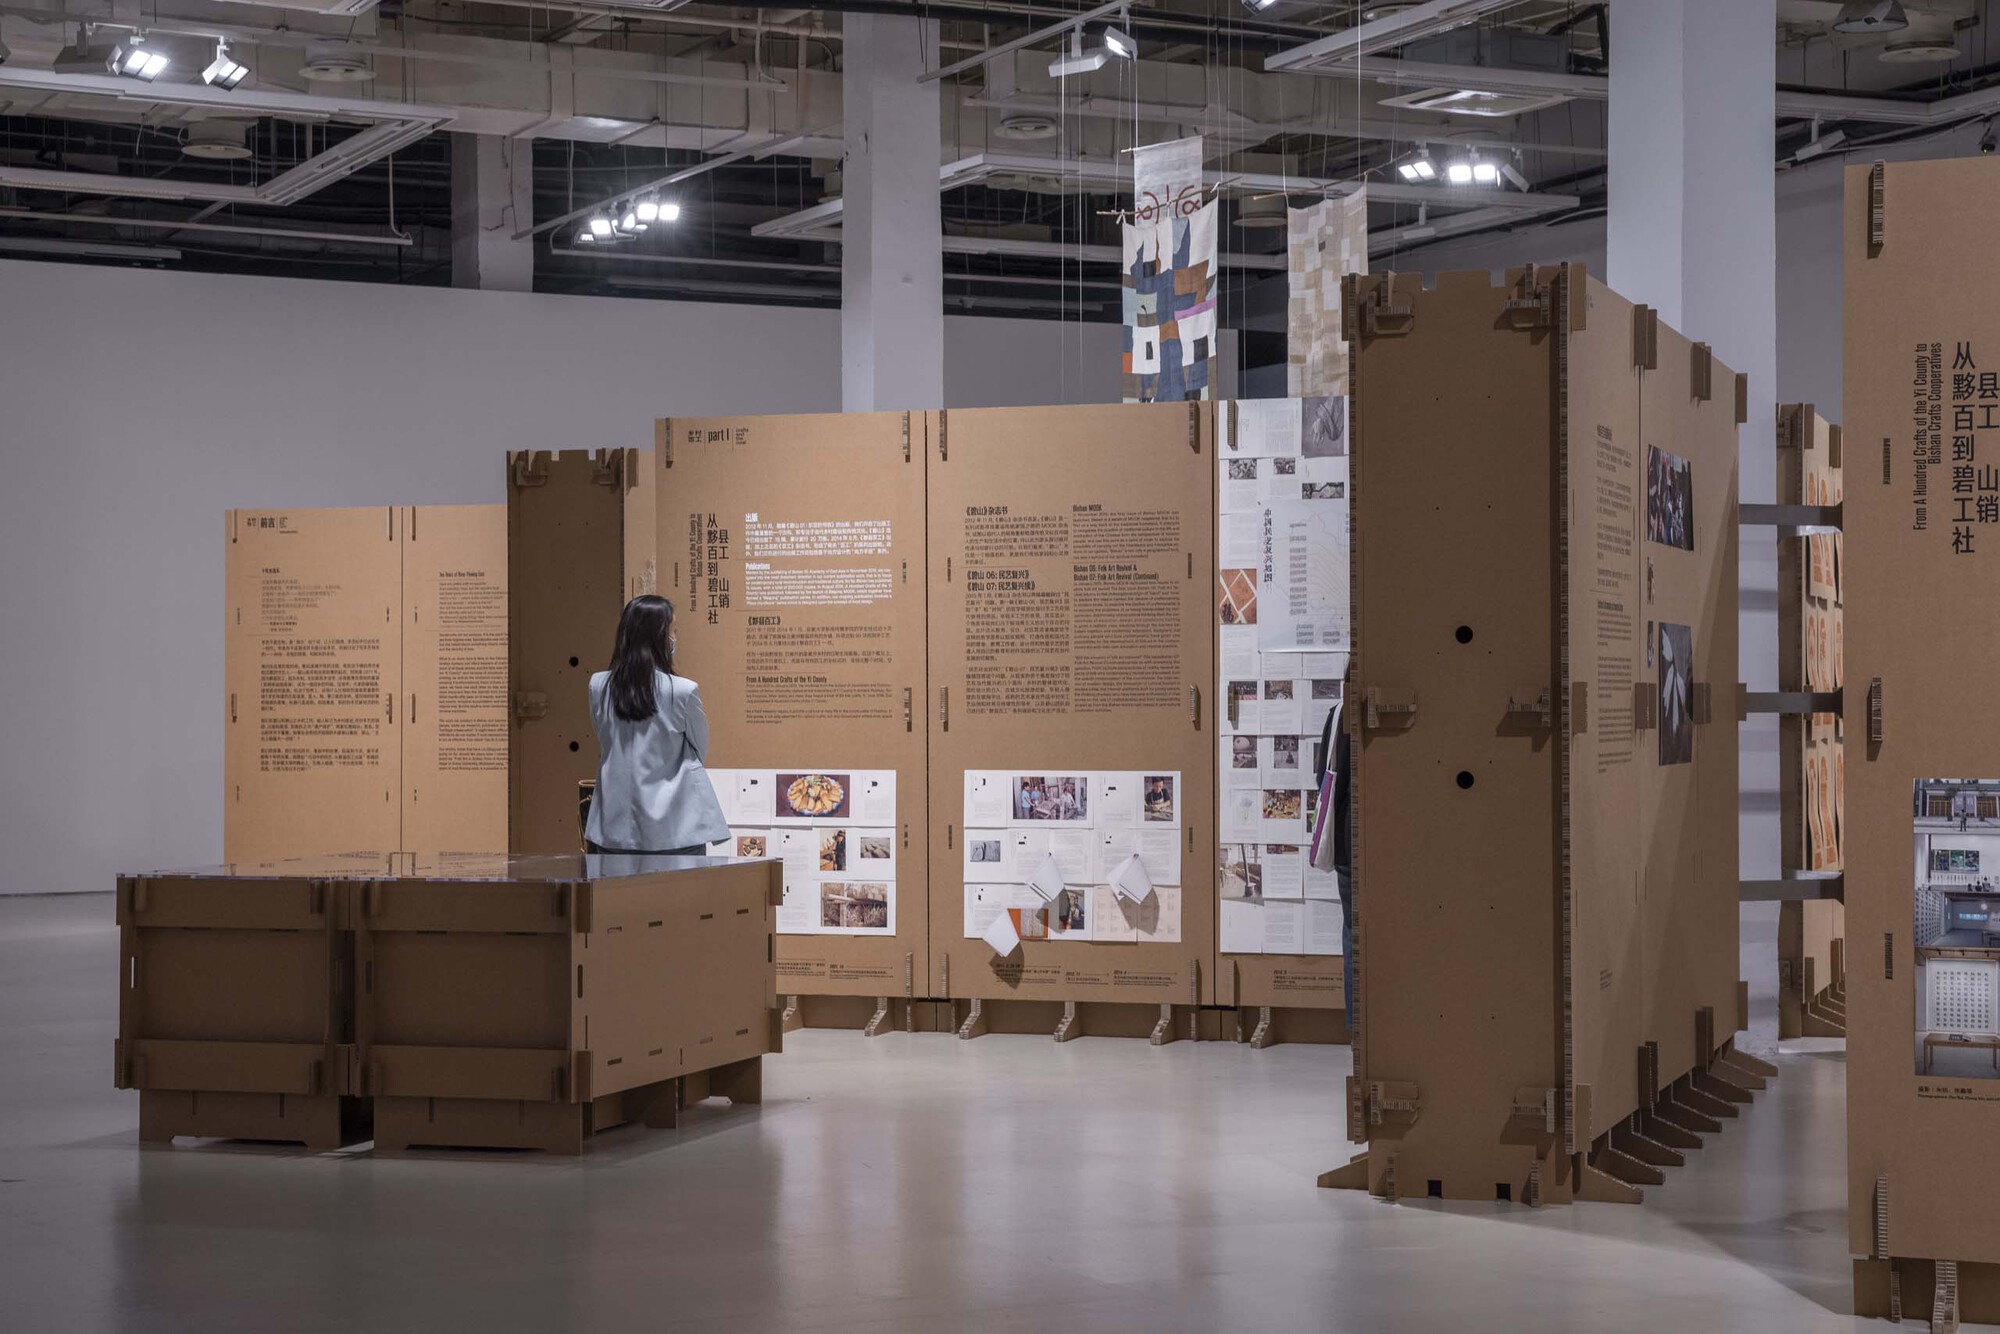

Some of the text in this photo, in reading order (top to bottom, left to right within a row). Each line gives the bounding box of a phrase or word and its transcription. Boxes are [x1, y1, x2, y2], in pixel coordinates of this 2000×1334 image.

[1913, 344, 1927, 353] to
[1913, 354, 1929, 386] County
[1913, 388, 1927, 398] Yi
[1913, 400, 1927, 414] the
[1928, 342, 1943, 464] Bishan Crafts Cooperatives
[1913, 417, 1927, 426] of
[708, 428, 724, 444] part
[1913, 429, 1927, 456] Crafts
[1913, 459, 1927, 496] Hundred
[1913, 508, 1927, 530] From
